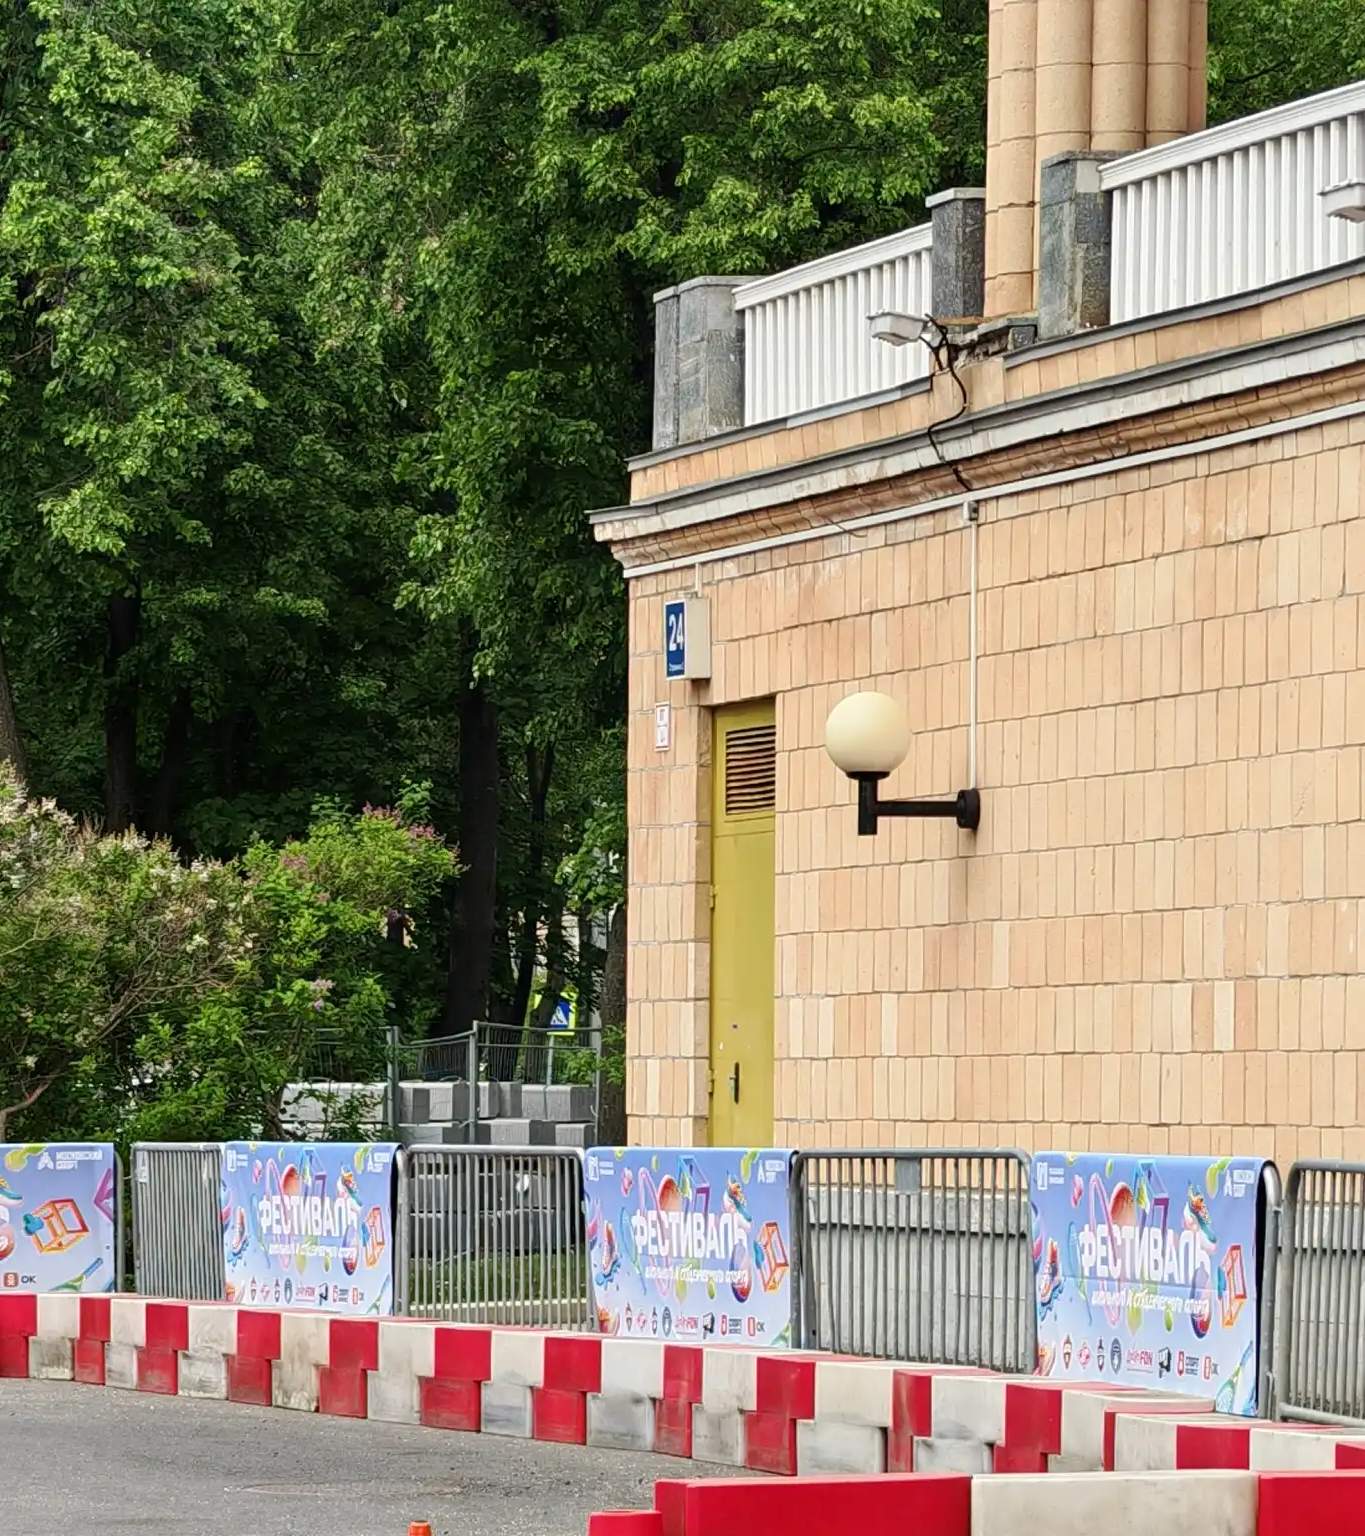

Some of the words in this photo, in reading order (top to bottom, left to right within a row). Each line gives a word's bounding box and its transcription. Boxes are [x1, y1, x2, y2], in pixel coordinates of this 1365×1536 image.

[668, 612, 684, 652] 24
[259, 1194, 358, 1237] ФЕСТИВАЛЬ
[631, 1209, 748, 1260] ФЕСТИВАЛЬ
[1079, 1223, 1212, 1285] ФЕСТИВАЛЬ
